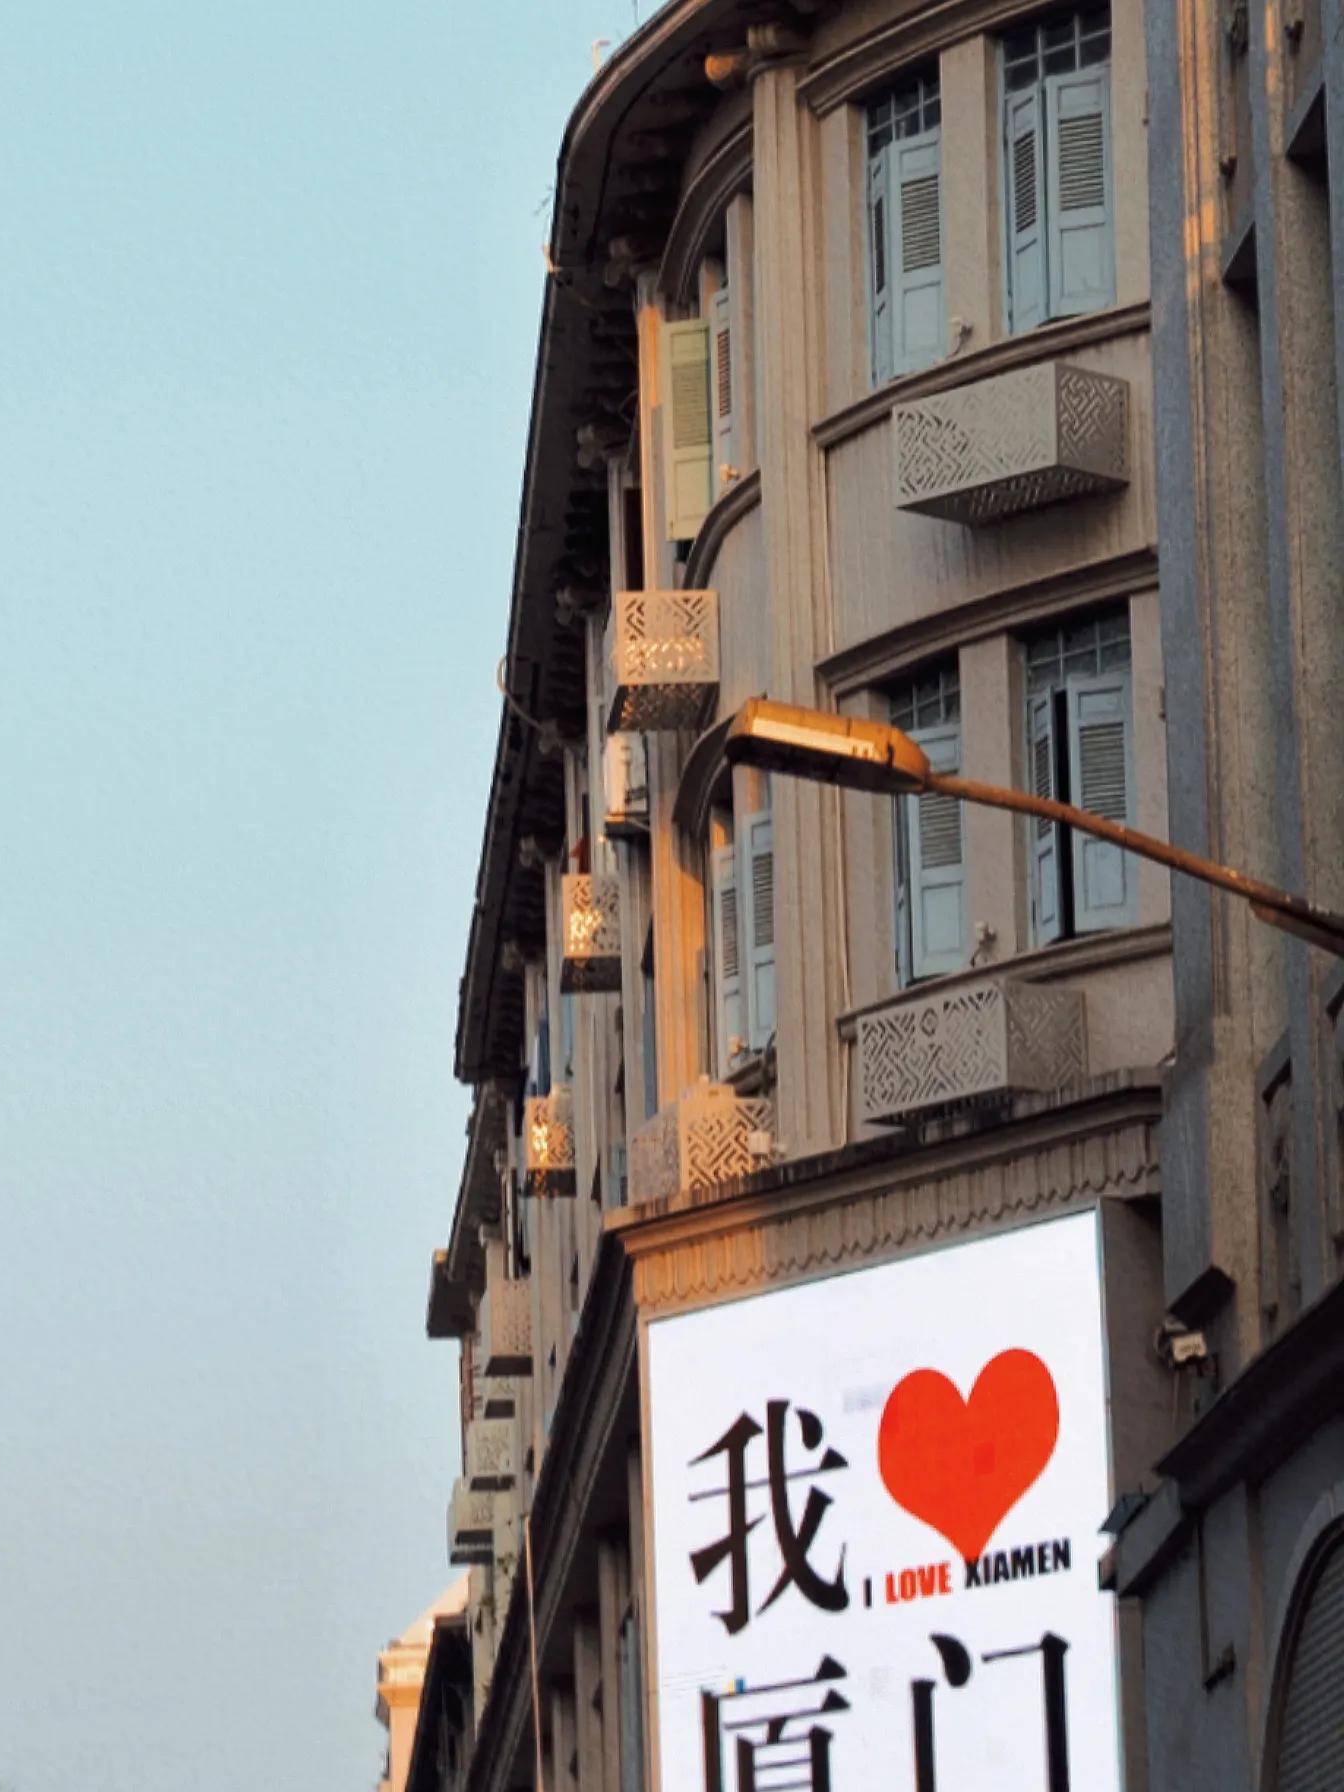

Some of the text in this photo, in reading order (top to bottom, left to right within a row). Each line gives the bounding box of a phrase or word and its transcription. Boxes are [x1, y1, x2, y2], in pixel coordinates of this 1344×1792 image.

[688, 1399, 850, 1636] 我
[863, 1537, 1072, 1609] I LOVE XIAMEN
